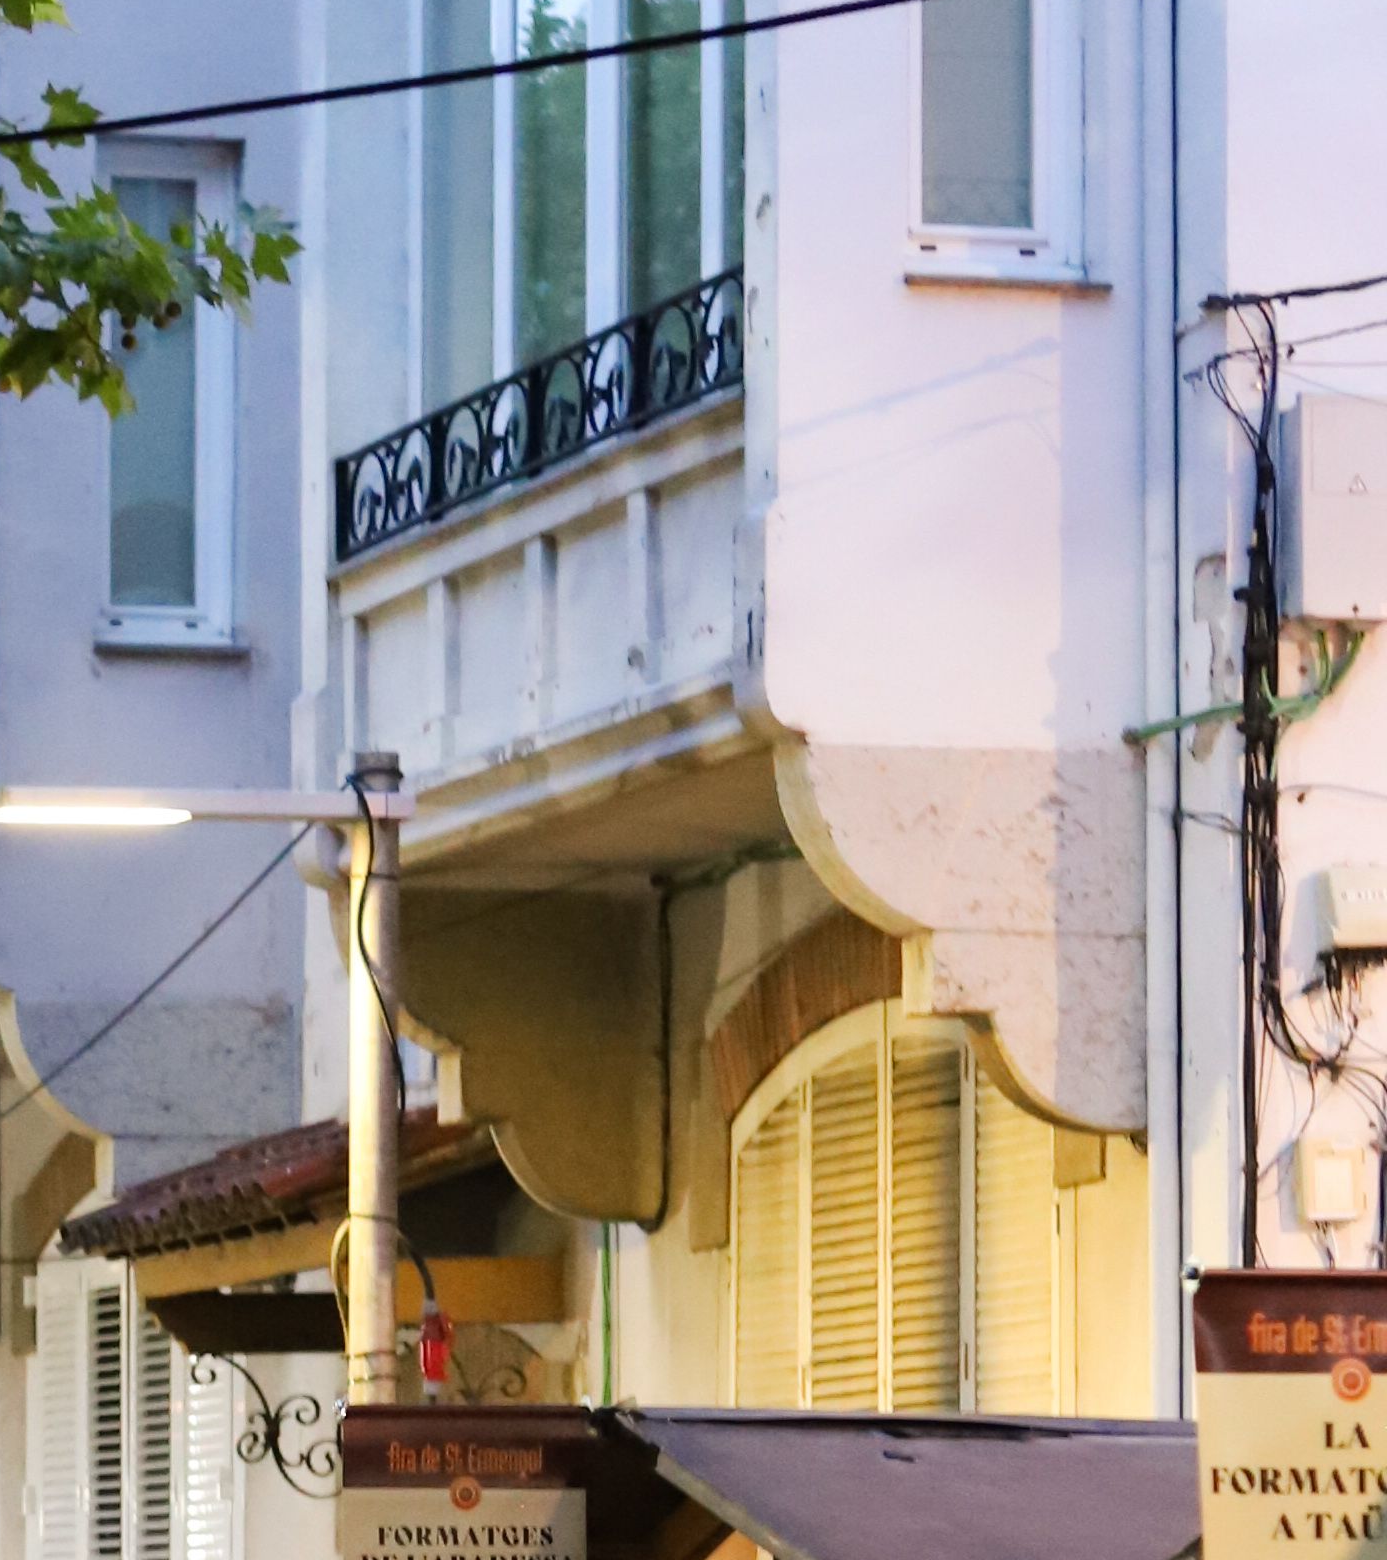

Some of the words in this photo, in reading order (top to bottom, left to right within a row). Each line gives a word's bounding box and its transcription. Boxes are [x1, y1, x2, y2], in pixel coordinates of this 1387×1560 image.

[1247, 1312, 1286, 1354] fira
[1292, 1315, 1319, 1354] de
[1324, 1421, 1370, 1449] LA
[388, 1441, 417, 1473] fira
[421, 1444, 440, 1472] de
[468, 1442, 543, 1476] Ermengol
[377, 1525, 554, 1546] FORMATGES
[1272, 1512, 1295, 1540] A
